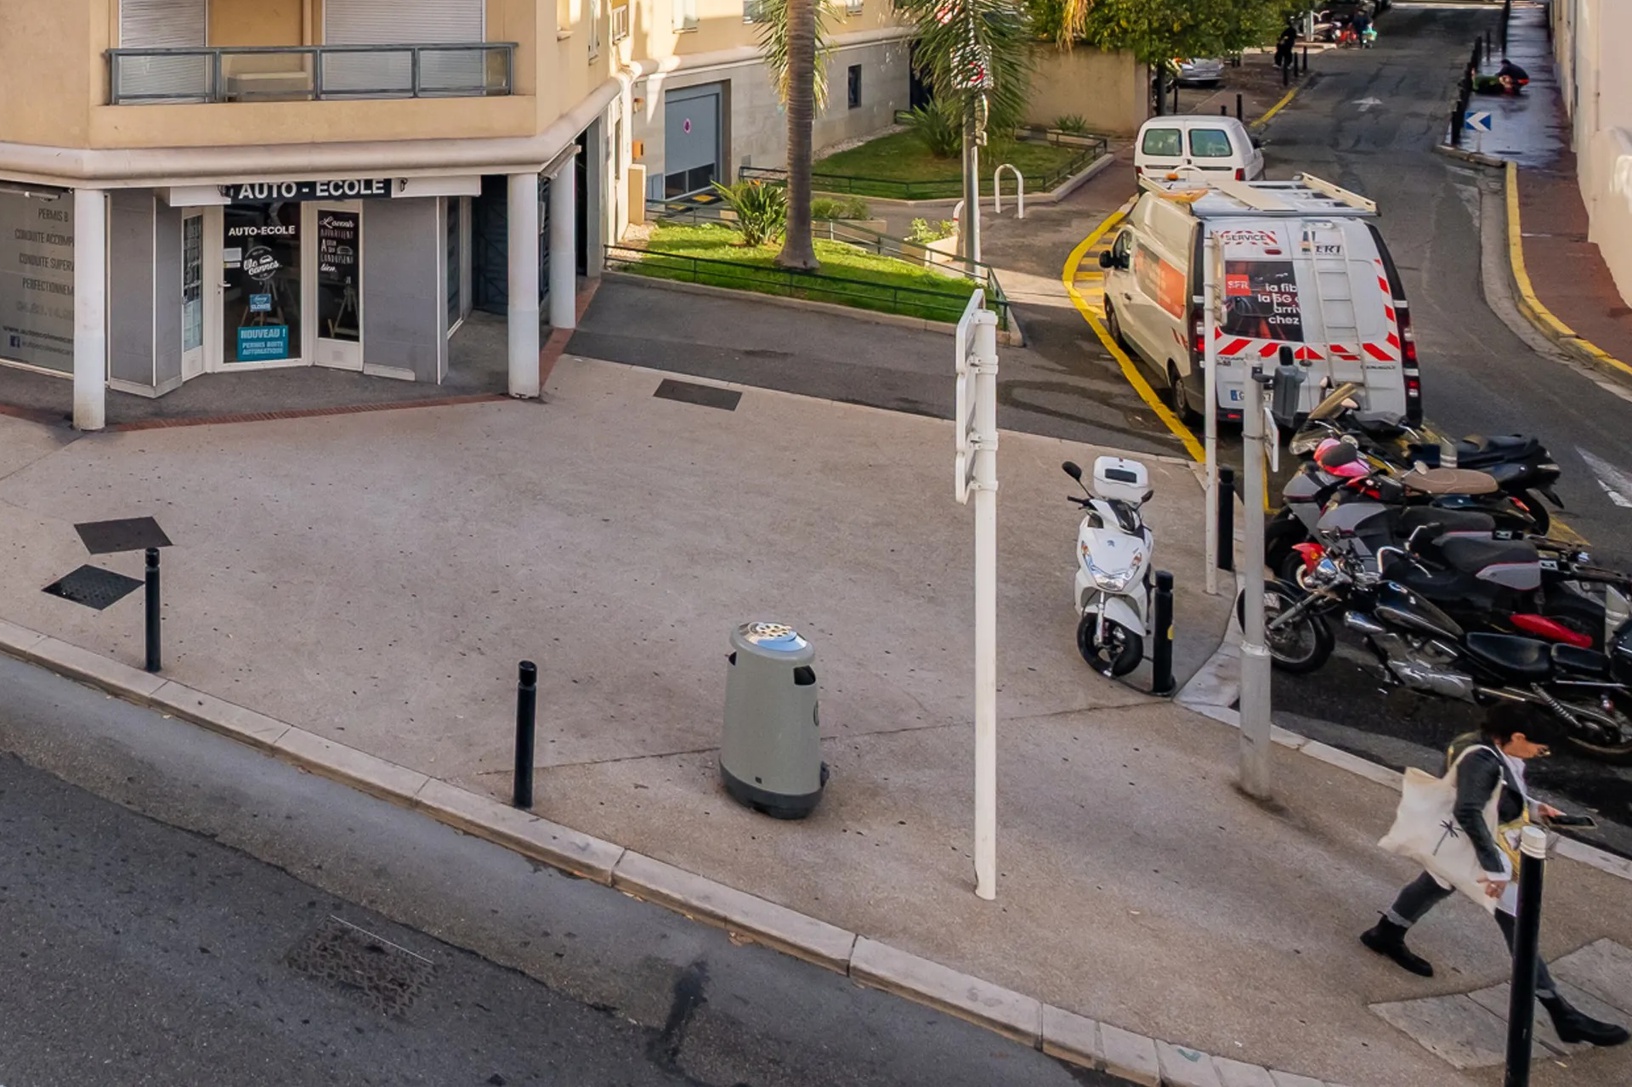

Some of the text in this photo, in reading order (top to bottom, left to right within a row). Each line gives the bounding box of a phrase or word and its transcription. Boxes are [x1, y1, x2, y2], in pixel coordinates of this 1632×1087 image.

[238, 182, 297, 199] AUTO
[315, 179, 385, 197] ECOLE
[38, 207, 63, 222] PERMIS
[228, 225, 296, 236] AUTO-ECOLE
[46, 233, 74, 248] ACCOMP
[50, 257, 74, 272] SUPER
[1227, 280, 1250, 289] SFR
[1265, 283, 1298, 292] la fib
[1258, 294, 1271, 303] la
[1268, 315, 1300, 325] chez
[240, 328, 280, 339] NOUVEAU
